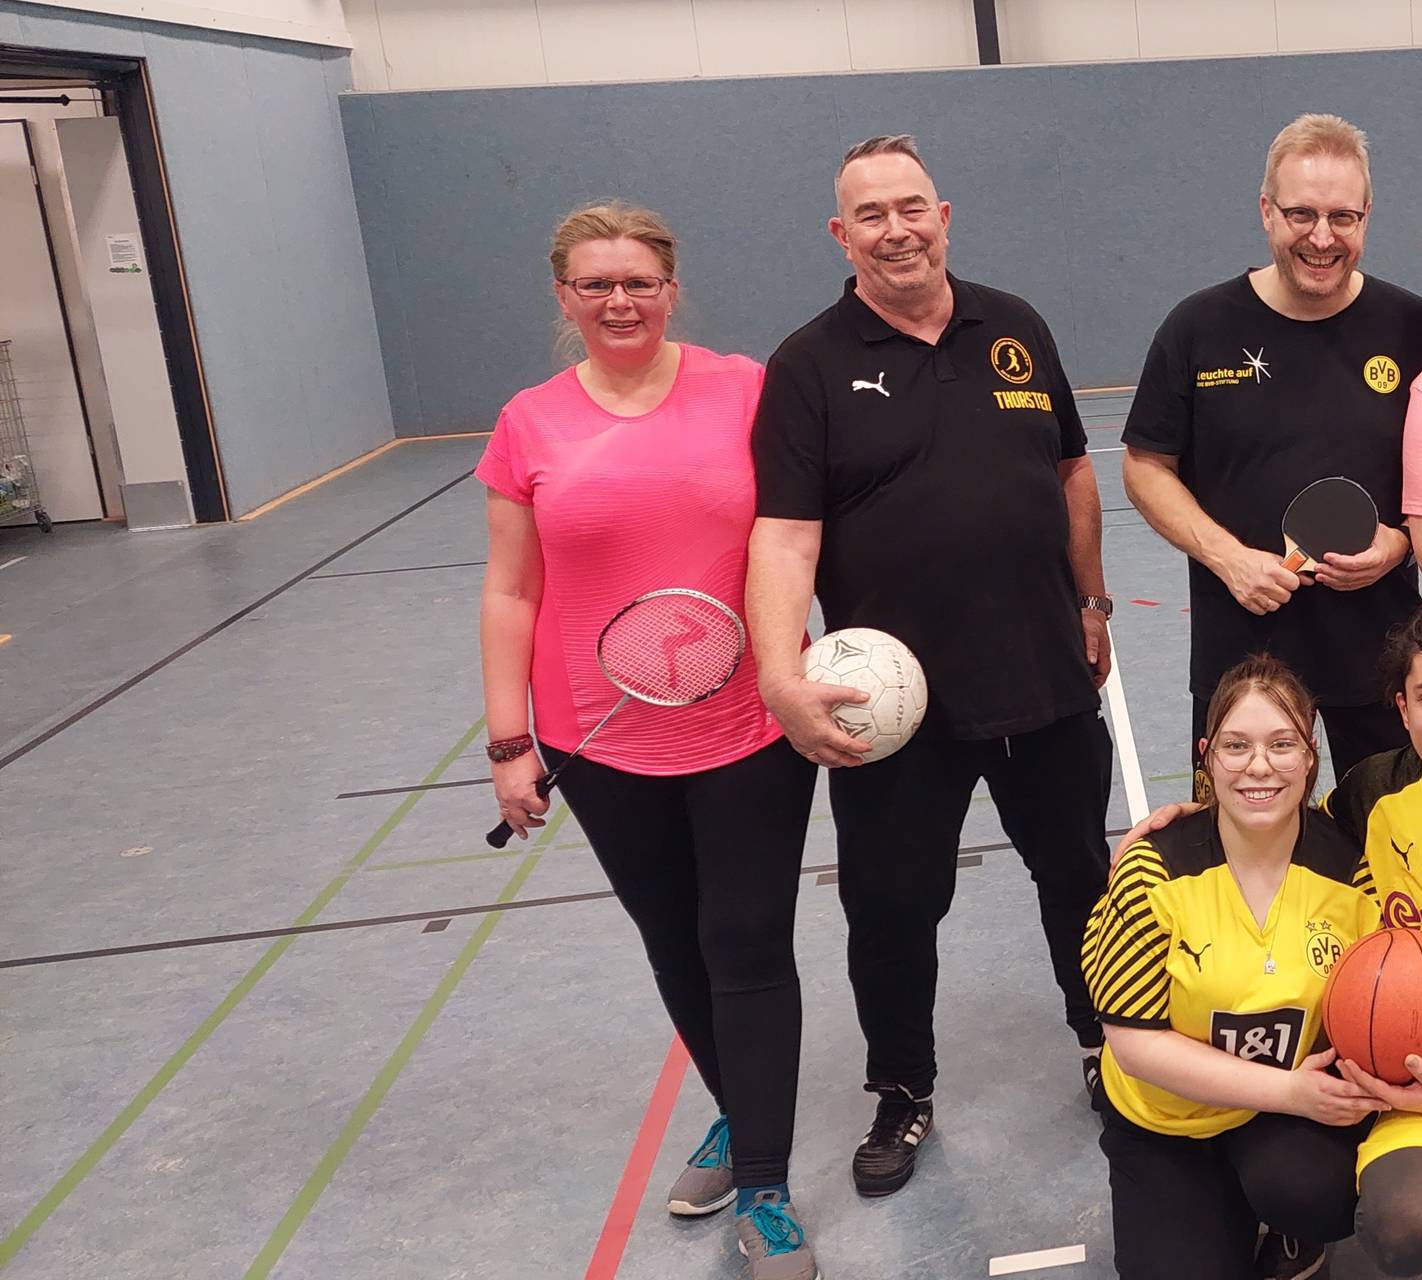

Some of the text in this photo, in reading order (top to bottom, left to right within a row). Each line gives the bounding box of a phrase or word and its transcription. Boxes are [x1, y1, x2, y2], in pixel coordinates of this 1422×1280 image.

[1235, 366, 1253, 378] auf
[1369, 359, 1397, 383] BVB
[1377, 381, 1388, 389] 09
[993, 391, 1053, 412] THORSTEN
[1219, 1023, 1292, 1064] 1&1
